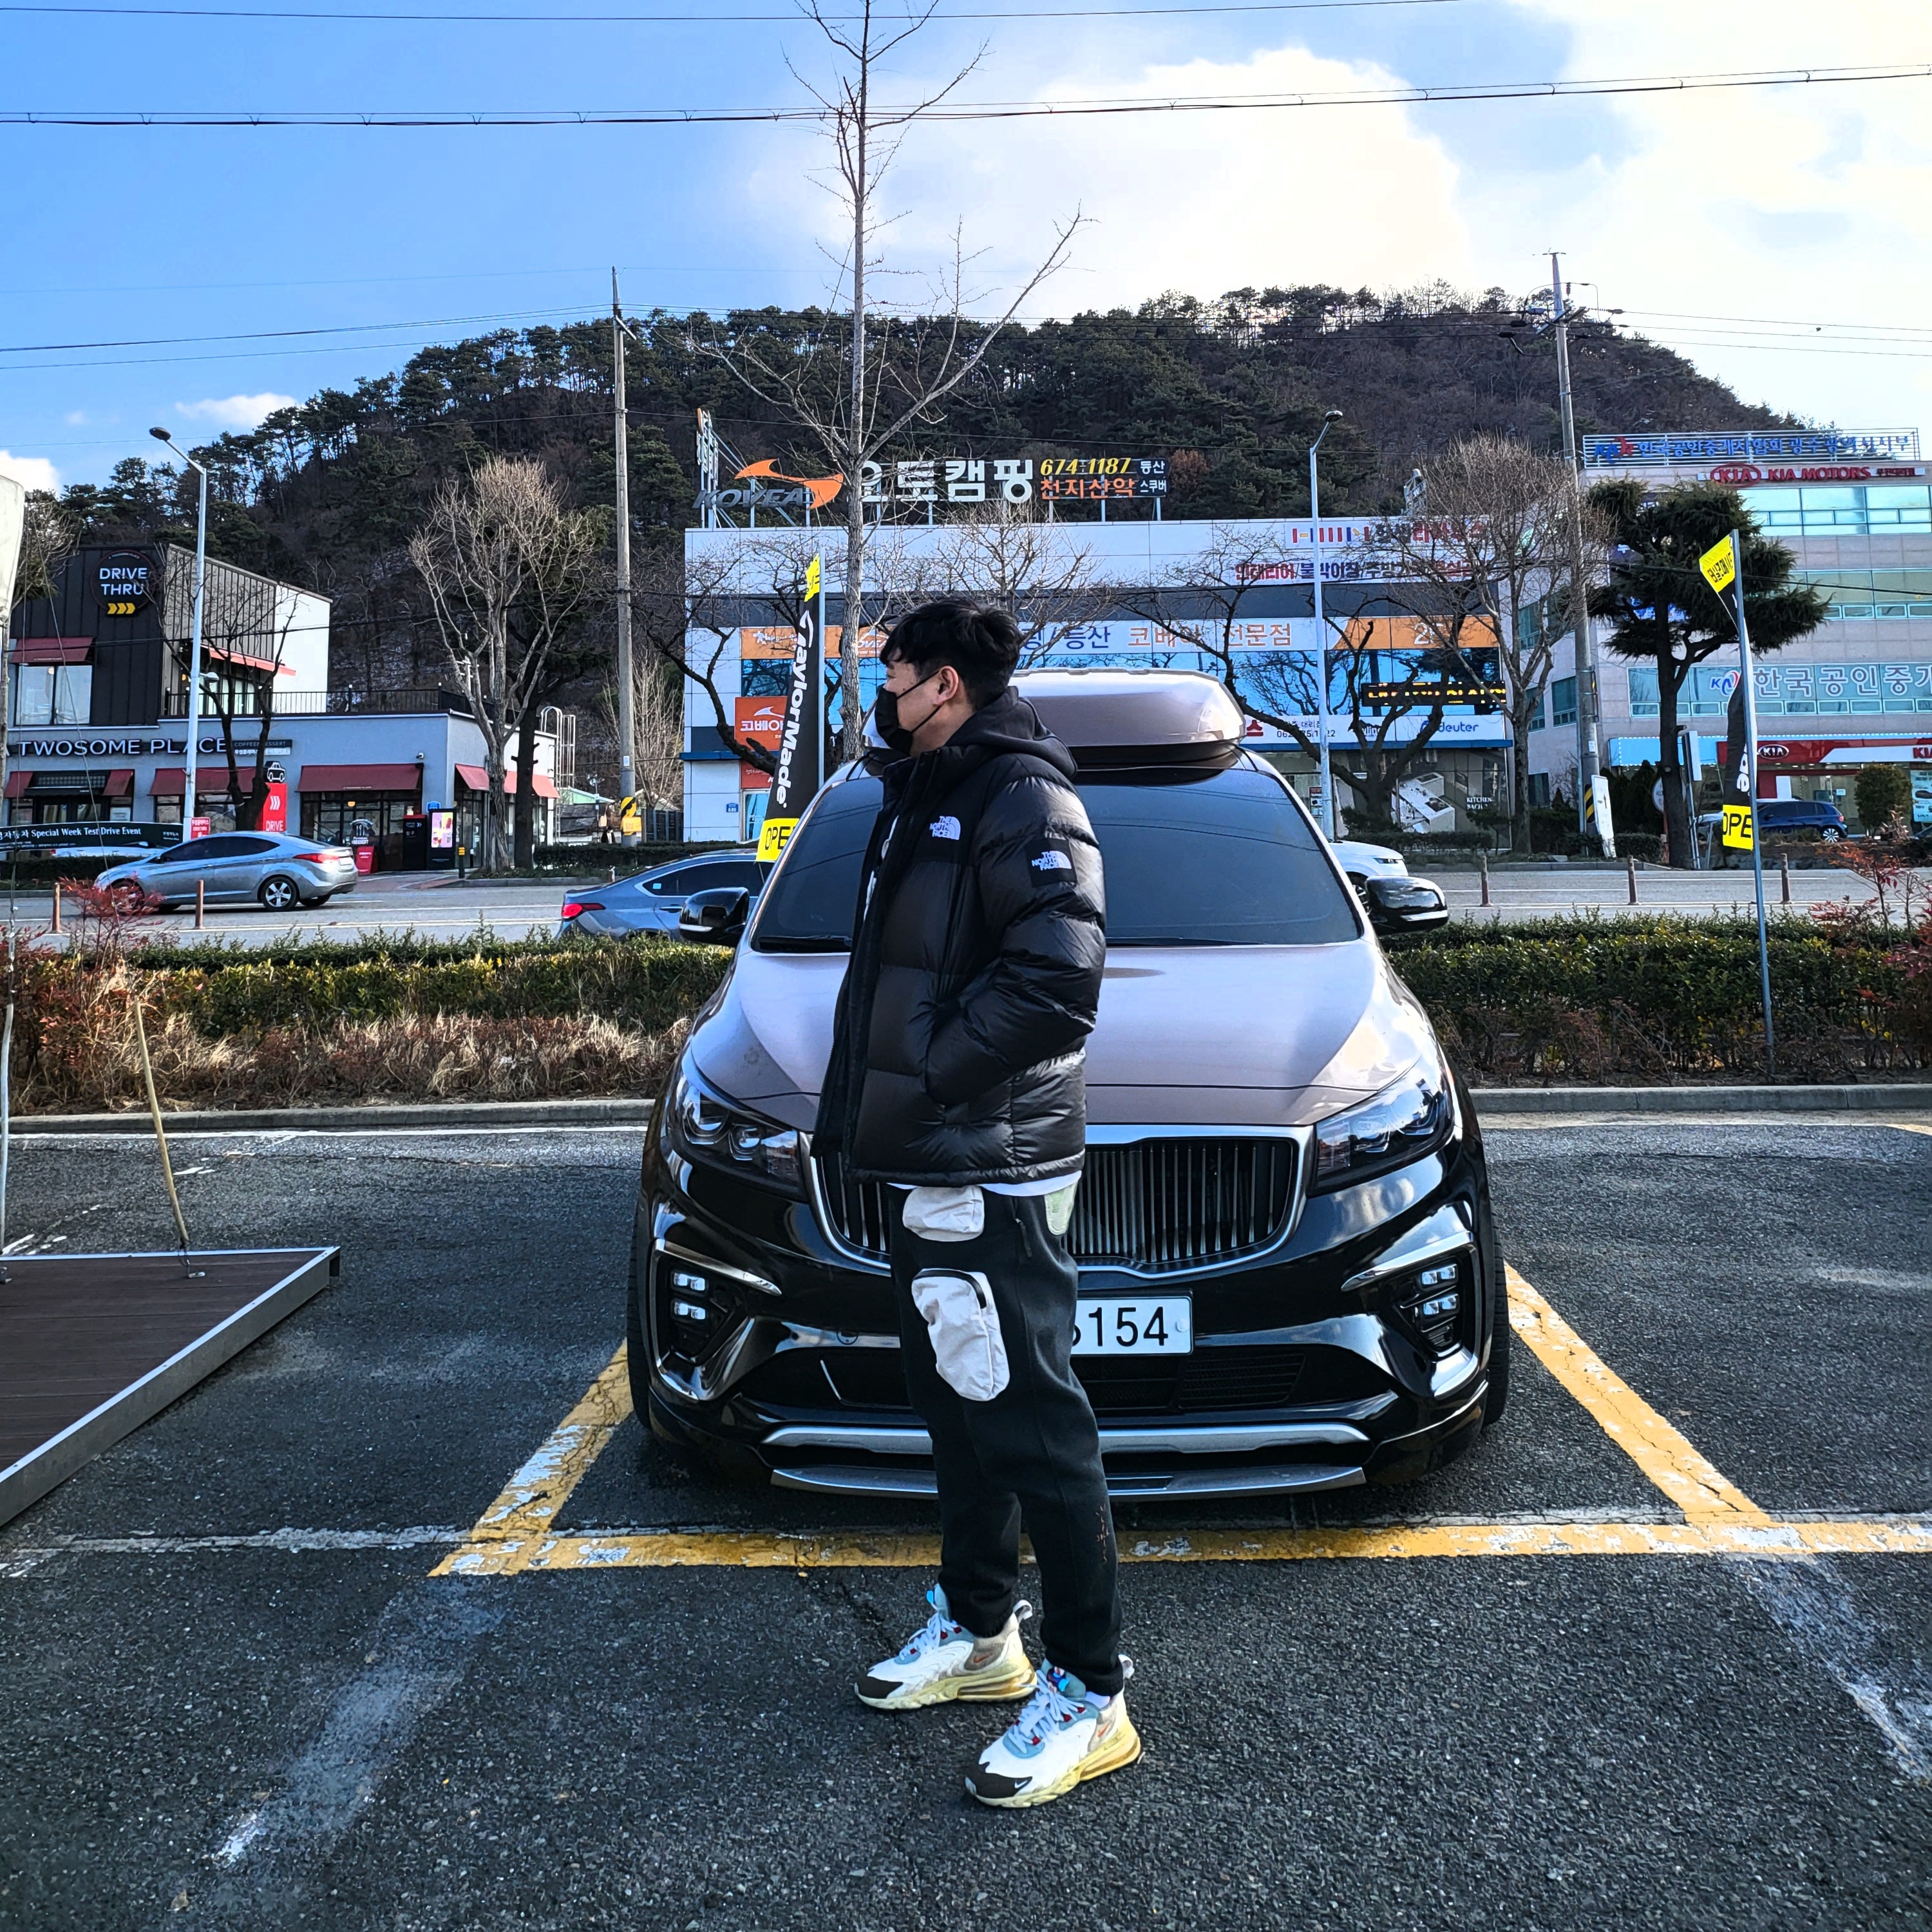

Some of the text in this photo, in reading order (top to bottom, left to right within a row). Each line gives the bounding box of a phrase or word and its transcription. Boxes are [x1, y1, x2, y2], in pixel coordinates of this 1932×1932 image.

[1040, 458, 1132, 476] 674-1187
[1140, 460, 1166, 474] 등산
[1719, 469, 1754, 482] KIA
[1768, 468, 1797, 481] KIA
[1801, 467, 1871, 480] MOTORS
[1040, 478, 1135, 500] 천지산악
[1140, 479, 1167, 493] 스쿠버
[692, 488, 803, 509] KOVEA
[99, 567, 147, 580] DRIVE
[100, 583, 144, 596] THRU
[17, 739, 140, 756] TWOSOME
[1763, 747, 1785, 756] KIA
[265, 820, 284, 831] DRIVE
[31, 828, 59, 839] Special
[61, 828, 82, 836] Week
[84, 827, 99, 836] Test
[100, 826, 120, 835] Drive
[122, 826, 142, 835] Event
[1031, 857, 1057, 867] NORTH
[1040, 862, 1059, 871] FACE
